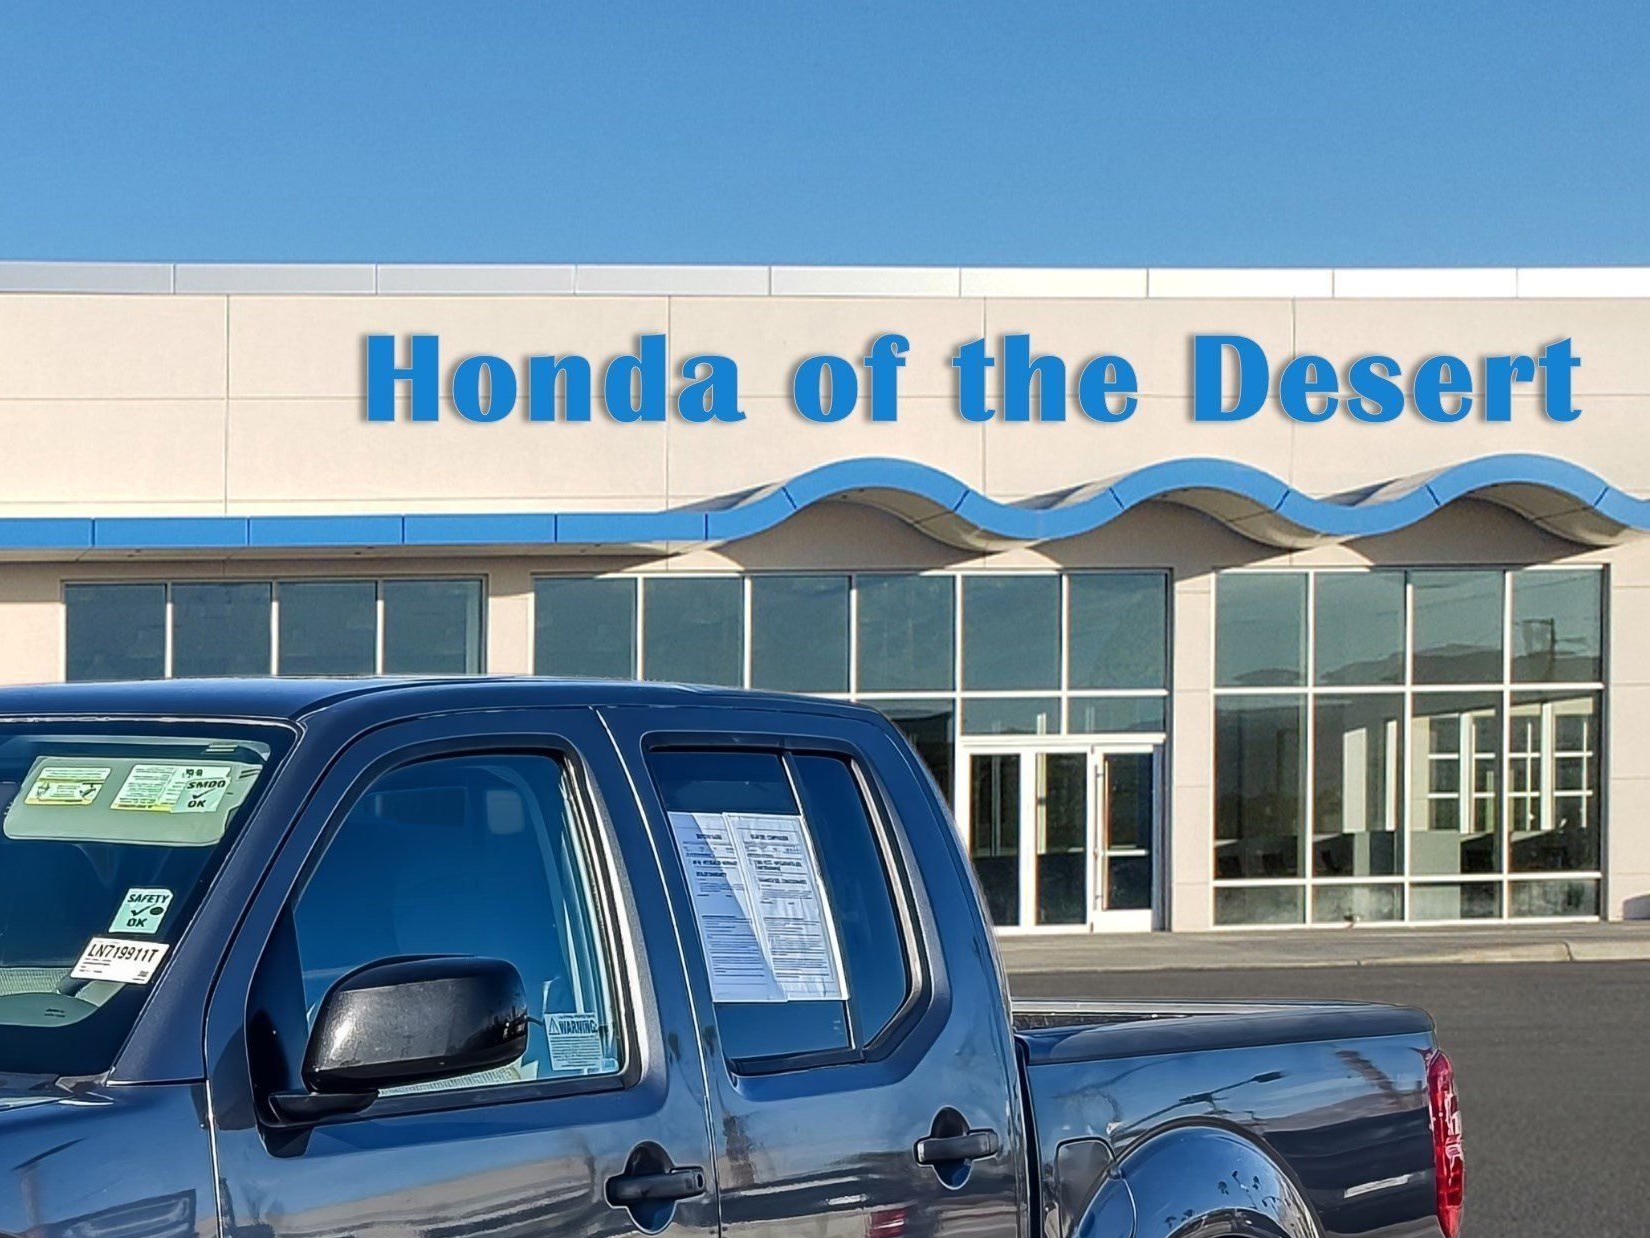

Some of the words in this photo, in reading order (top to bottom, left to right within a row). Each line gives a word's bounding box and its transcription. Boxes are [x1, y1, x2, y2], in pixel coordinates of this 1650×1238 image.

[367, 333, 747, 423] Honda
[793, 333, 910, 423] of
[952, 333, 1138, 423] the
[1194, 335, 1582, 423] Desert
[188, 799, 207, 808] OK
[127, 893, 170, 903] SAFETY
[126, 917, 148, 928] OK
